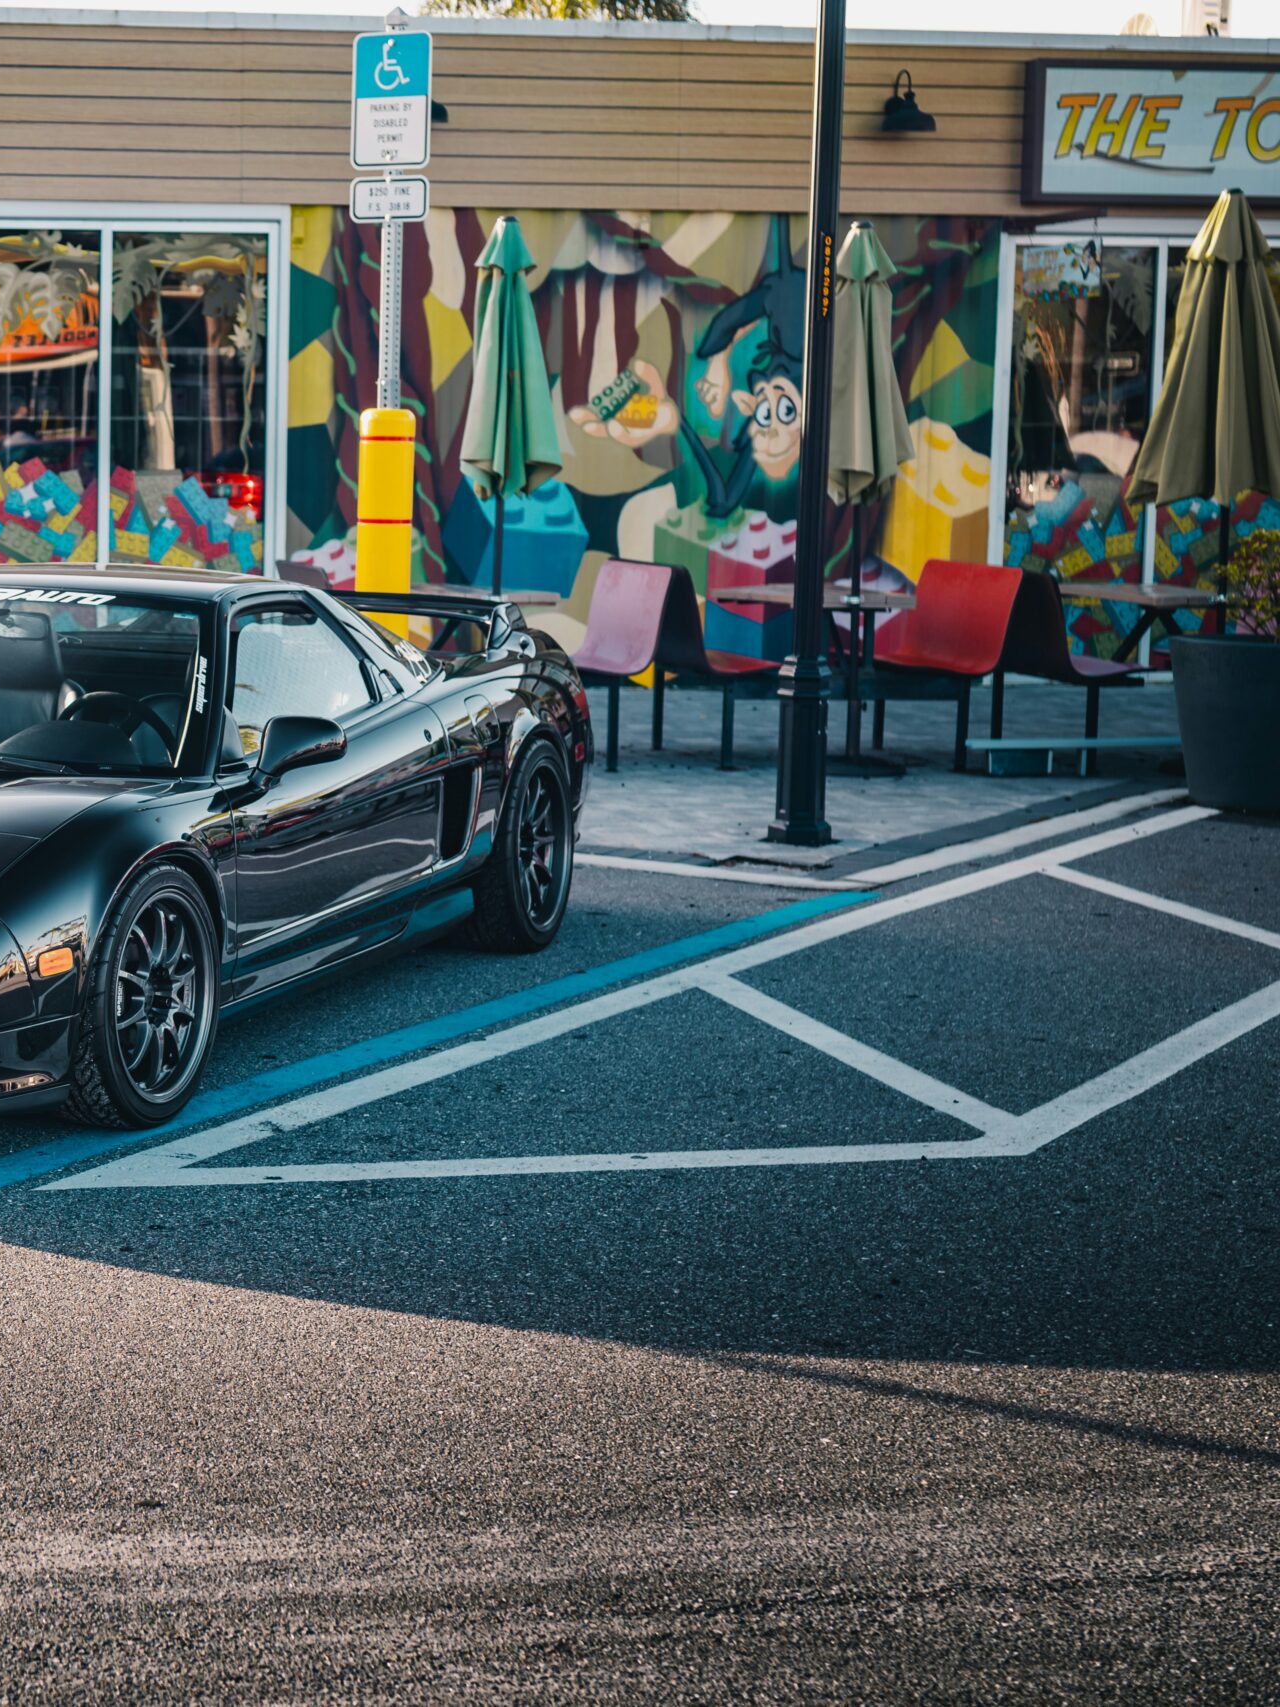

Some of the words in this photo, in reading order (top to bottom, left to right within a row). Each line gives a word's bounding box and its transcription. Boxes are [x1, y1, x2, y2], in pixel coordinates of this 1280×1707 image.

[370, 103, 399, 112] PARKING
[403, 102, 411, 111] BY
[373, 117, 408, 128] DISABLED
[1054, 92, 1183, 160] THE
[377, 133, 403, 143] PERMIT
[369, 187, 389, 197] $250
[394, 186, 410, 196] FINE
